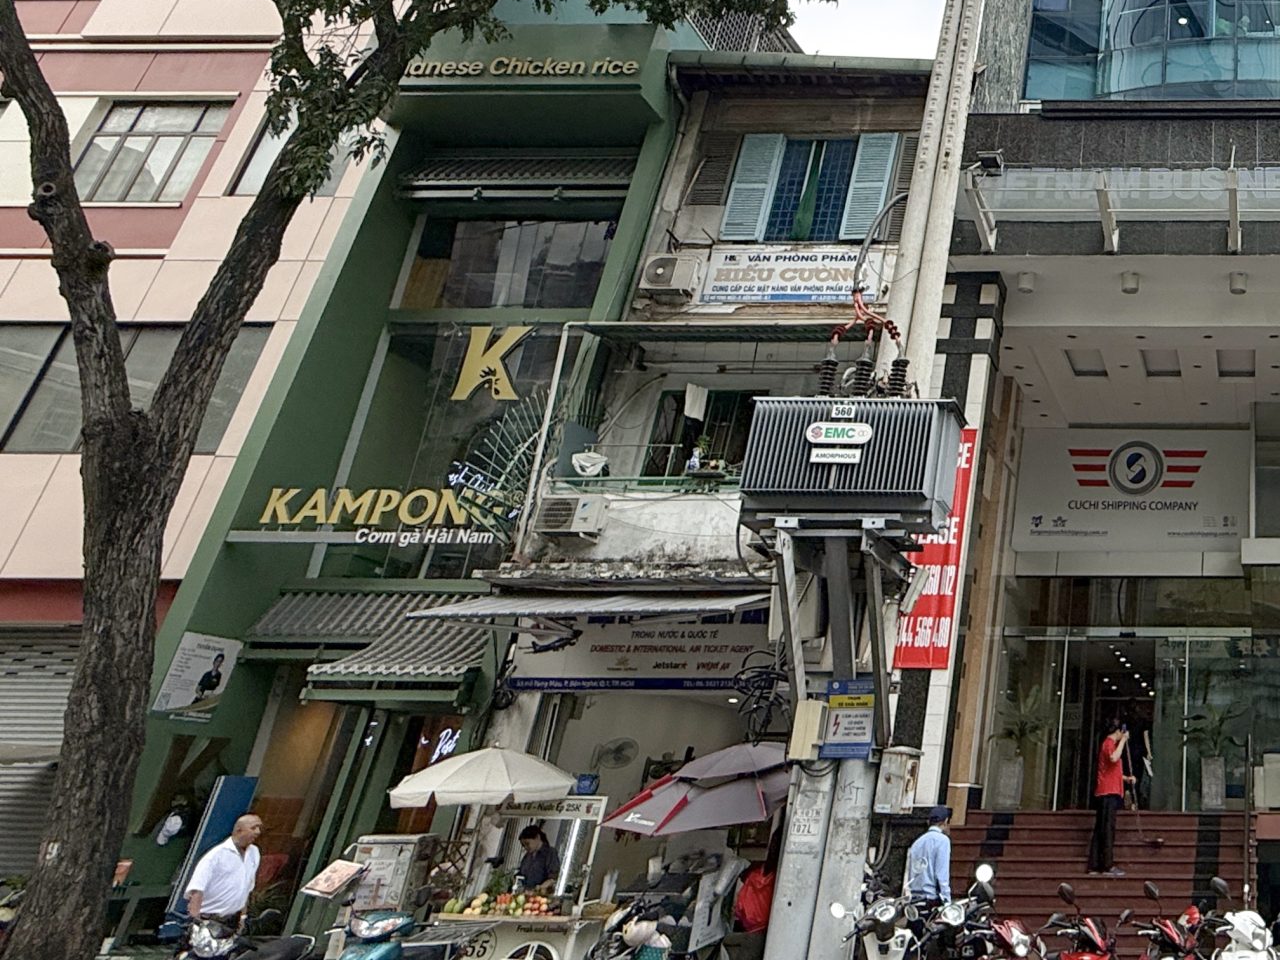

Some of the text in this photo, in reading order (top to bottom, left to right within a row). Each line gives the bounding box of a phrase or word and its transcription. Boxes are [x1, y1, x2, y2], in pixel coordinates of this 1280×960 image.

[489, 57, 584, 76] Chicken
[591, 57, 639, 75] rice
[775, 253, 818, 262] PHÒNG
[451, 326, 534, 400] K
[834, 406, 852, 416] 560
[824, 427, 855, 439] EMC
[1068, 500, 1198, 511] CUCHI SHIPPING COMPANY
[355, 528, 494, 546] Cơm gà Hải Nam
[591, 645, 626, 653] DOMESTIC
[633, 644, 686, 653] INTERNATIONAL
[689, 645, 701, 653] AIR
[704, 645, 728, 653] TICKET
[731, 645, 754, 653] AGENT
